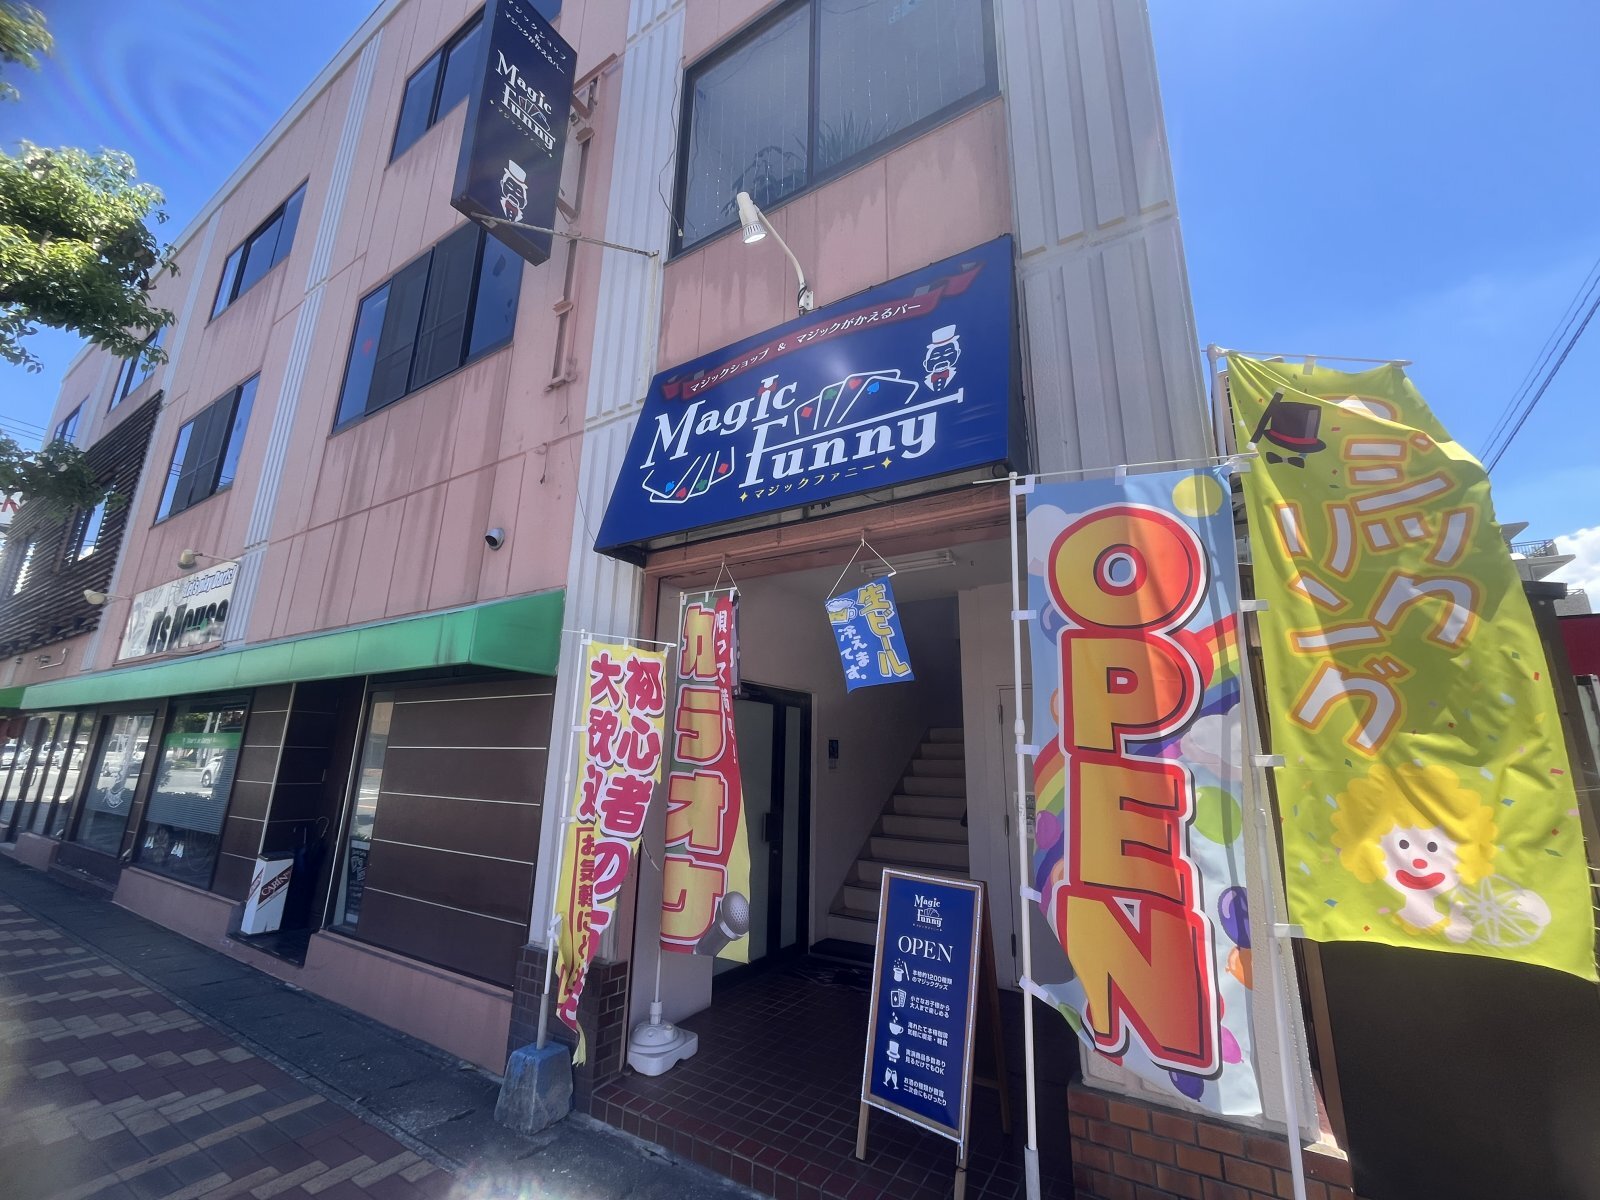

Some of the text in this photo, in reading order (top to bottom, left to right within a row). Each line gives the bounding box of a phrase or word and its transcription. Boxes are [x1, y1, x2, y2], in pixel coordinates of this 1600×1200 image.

[495, 49, 553, 115] Magic
[500, 82, 557, 150] Funny
[690, 303, 921, 392] マジックショップ & マジックがかえるバー
[640, 374, 798, 469] Magic
[738, 387, 965, 489] Funny
[754, 464, 876, 499] マジックファニー
[856, 583, 912, 678] 生ビール
[660, 602, 729, 946] カラオケ
[1045, 502, 1224, 1079] OPEN
[261, 872, 289, 897] CABIN
[914, 894, 941, 908] Magic
[898, 935, 954, 963] OPEN
[917, 908, 943, 928] Funny
[910, 995, 950, 1012] 小さなお子様から
[911, 976, 948, 991] のマジックグッズ
